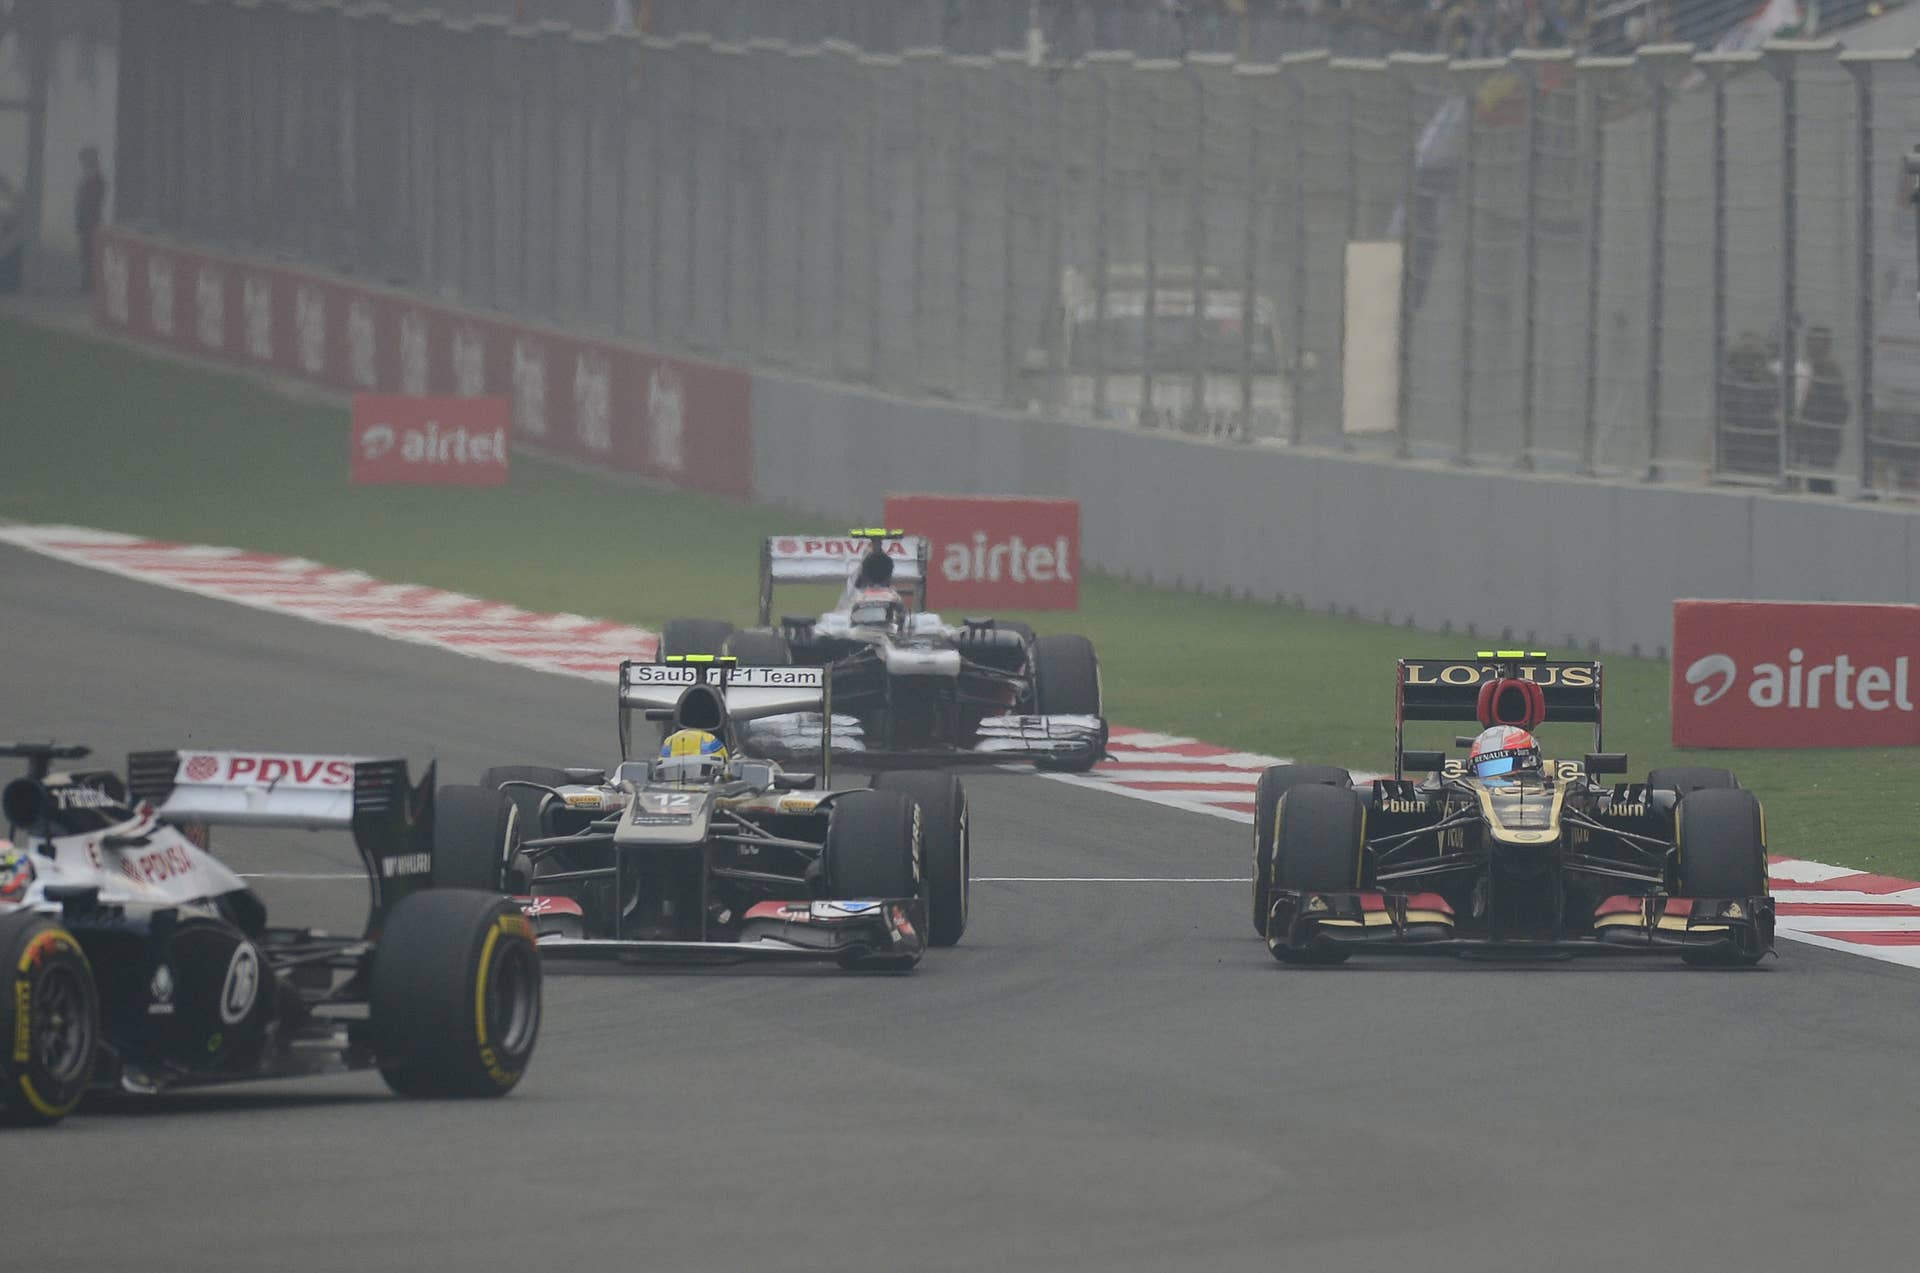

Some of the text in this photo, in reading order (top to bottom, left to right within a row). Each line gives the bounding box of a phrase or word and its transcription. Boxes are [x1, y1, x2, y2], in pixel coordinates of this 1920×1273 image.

[402, 420, 507, 464] airtel
[804, 540, 907, 555] PDVA
[942, 531, 1071, 583] airtel
[639, 668, 816, 683] Saubr F1 Team
[1748, 648, 1914, 711] airtel
[1474, 750, 1510, 763] RENAULT
[654, 793, 689, 806] 12
[1391, 799, 1425, 813] burn
